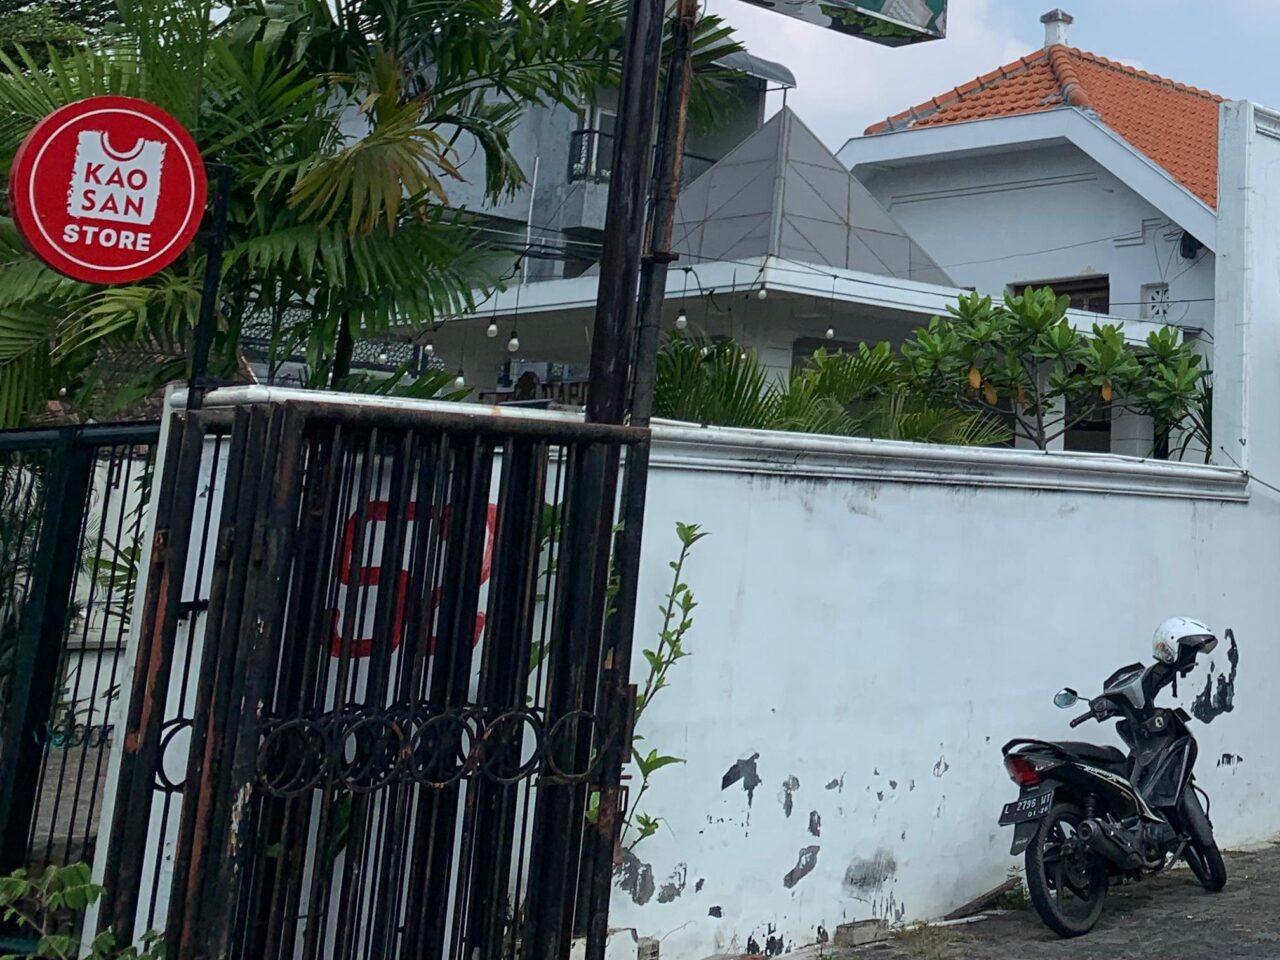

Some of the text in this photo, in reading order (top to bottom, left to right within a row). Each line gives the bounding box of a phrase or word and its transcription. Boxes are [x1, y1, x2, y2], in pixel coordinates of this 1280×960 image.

[84, 162, 148, 191] KAO
[81, 189, 144, 218] SAN
[62, 224, 152, 252] STORE
